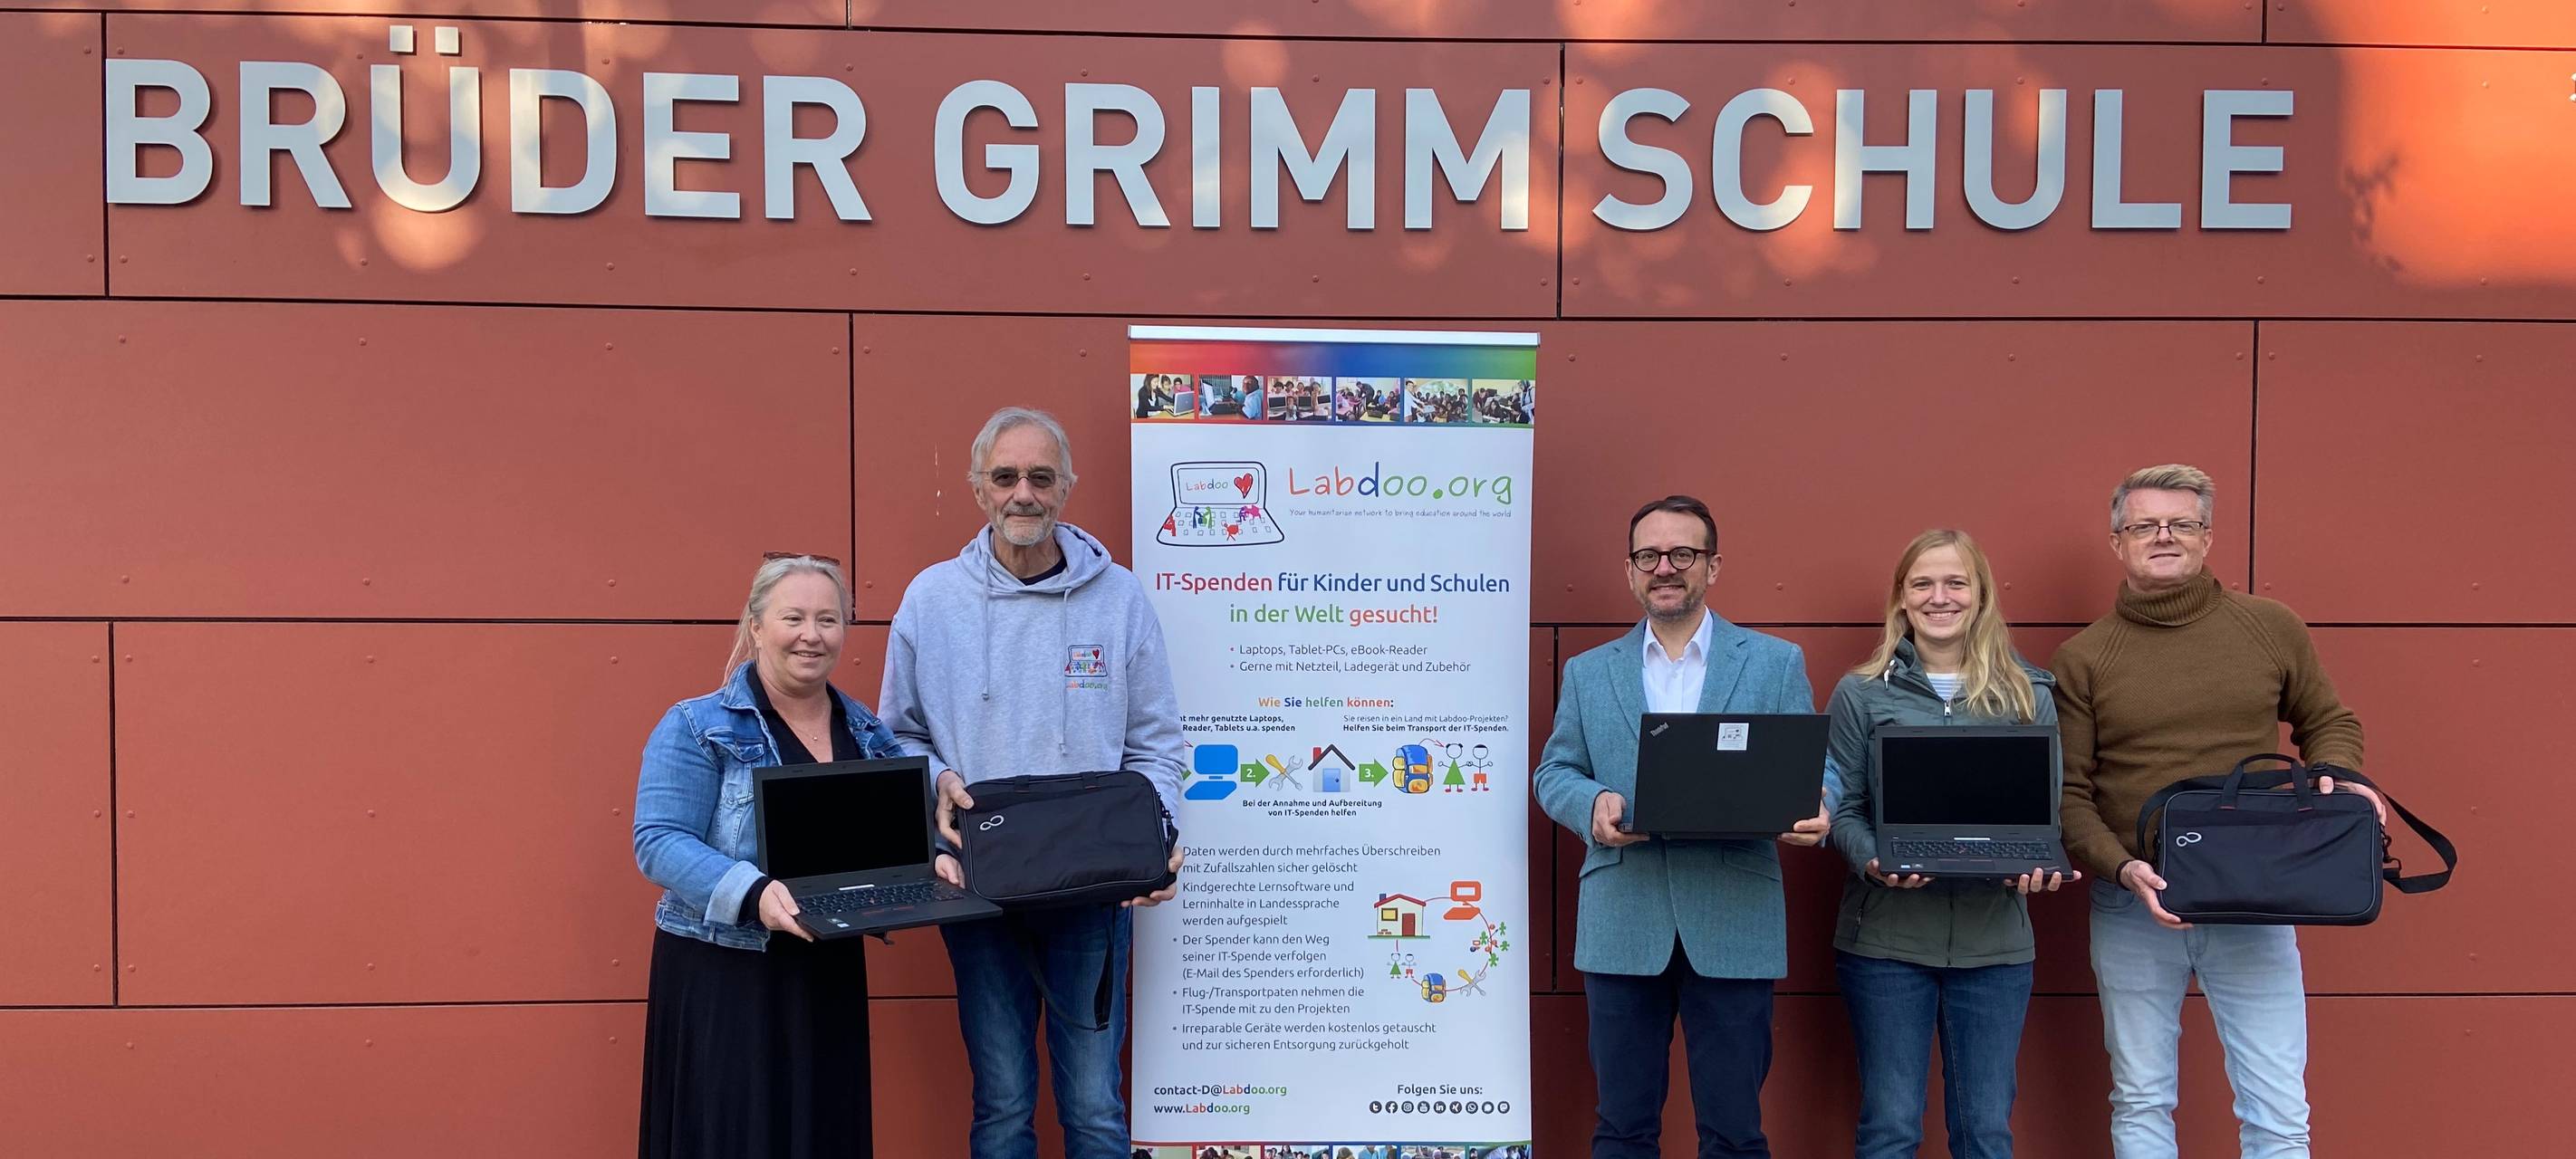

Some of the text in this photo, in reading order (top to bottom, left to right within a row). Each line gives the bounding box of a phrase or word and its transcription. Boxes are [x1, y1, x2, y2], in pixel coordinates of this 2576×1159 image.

[105, 25, 2294, 232] BRÜDER GRIMM SCHULE
[1187, 478, 1228, 491] Labdoo
[1290, 462, 1511, 504] Labdoo.org
[1395, 510, 1413, 518] bring
[1453, 509, 1476, 519] around
[1157, 572, 1509, 595] IT-Spenden für Kinder und Schulen
[1231, 604, 1437, 627] in der Welt gesucht!
[1240, 645, 1427, 656] Laptops, Tablet-PCs, eBook-Reader
[1239, 661, 1471, 674] Gerne mit Netzteil, Ladegerät und Zubehör
[1258, 697, 1393, 707] Wie Sie helfen können:
[1343, 714, 1355, 723] Sie
[1357, 714, 1380, 723] reisen
[1262, 724, 1295, 733] spenden
[1464, 724, 1508, 733] IT-Spenden.
[1246, 768, 1256, 778] 2.
[1365, 768, 1374, 778] 3.
[1329, 800, 1381, 808] Aufbereitung
[1183, 844, 1440, 858] Daten werden durch mehrfaches Überschreiben
[1182, 861, 1357, 874] mit Zufallszahlen sicher gelöscht
[1182, 881, 1353, 894] Kindgerechte Lernsoftware und
[1183, 898, 1244, 909] Lerninhalte
[1260, 898, 1339, 910] Landessprache
[1183, 915, 1287, 927] werden aufgespielt
[1183, 934, 1329, 946] Der Spender kann den Weg
[1183, 951, 1326, 963] seiner IT-Spende verfolgen
[1183, 967, 1363, 980] (E-Mail des Spenders erforderlich)
[1183, 986, 1364, 999] Flug-/Transportpaten nehmen die
[1183, 1004, 1235, 1016] IT-Spende
[1239, 1004, 1256, 1013] mit
[1274, 1003, 1294, 1013] den
[1298, 1003, 1350, 1015] Projekten
[1183, 1022, 1436, 1035] Irreparable Geräte werden kostenlos getauscht
[1183, 1039, 1202, 1049] und
[1226, 1039, 1270, 1049] sicheren
[1274, 1040, 1335, 1051] Entsorgung
[1339, 1039, 1408, 1051] zurückgeholt
[1154, 1085, 1286, 1097] contact-D@Labdoo.org
[1398, 1084, 1483, 1096] Folgen Sie uns:
[1154, 1103, 1249, 1115] www.Labdoo.org
